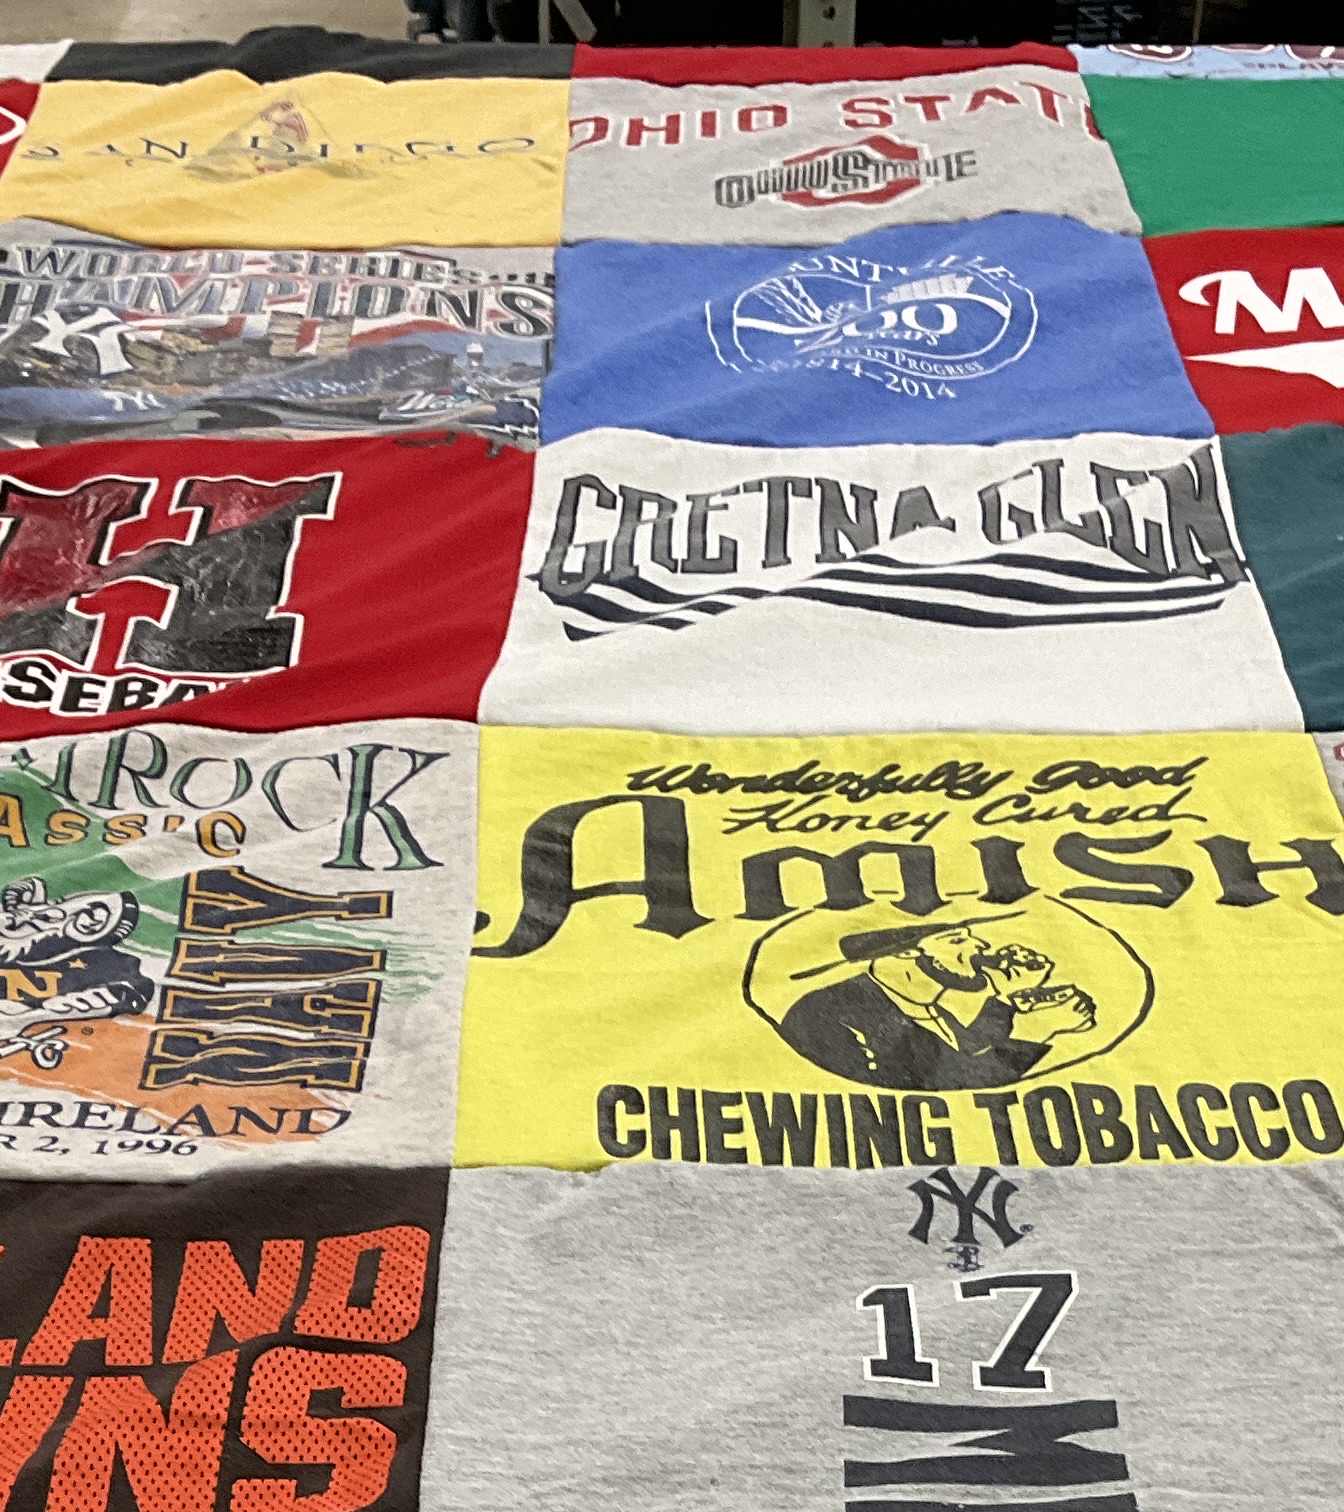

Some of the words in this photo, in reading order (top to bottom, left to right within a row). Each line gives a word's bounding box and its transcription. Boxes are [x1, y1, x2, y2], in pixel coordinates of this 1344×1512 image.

[541, 474, 955, 595] GRETNA
[626, 759, 1017, 802] Wonderfully
[1024, 756, 1209, 793] Good
[720, 796, 954, 840] Honey
[976, 788, 1211, 827] Cured
[92, 1135, 200, 1158] 1996
[594, 1081, 957, 1169] CHEWING
[855, 1269, 1080, 1393] 17
